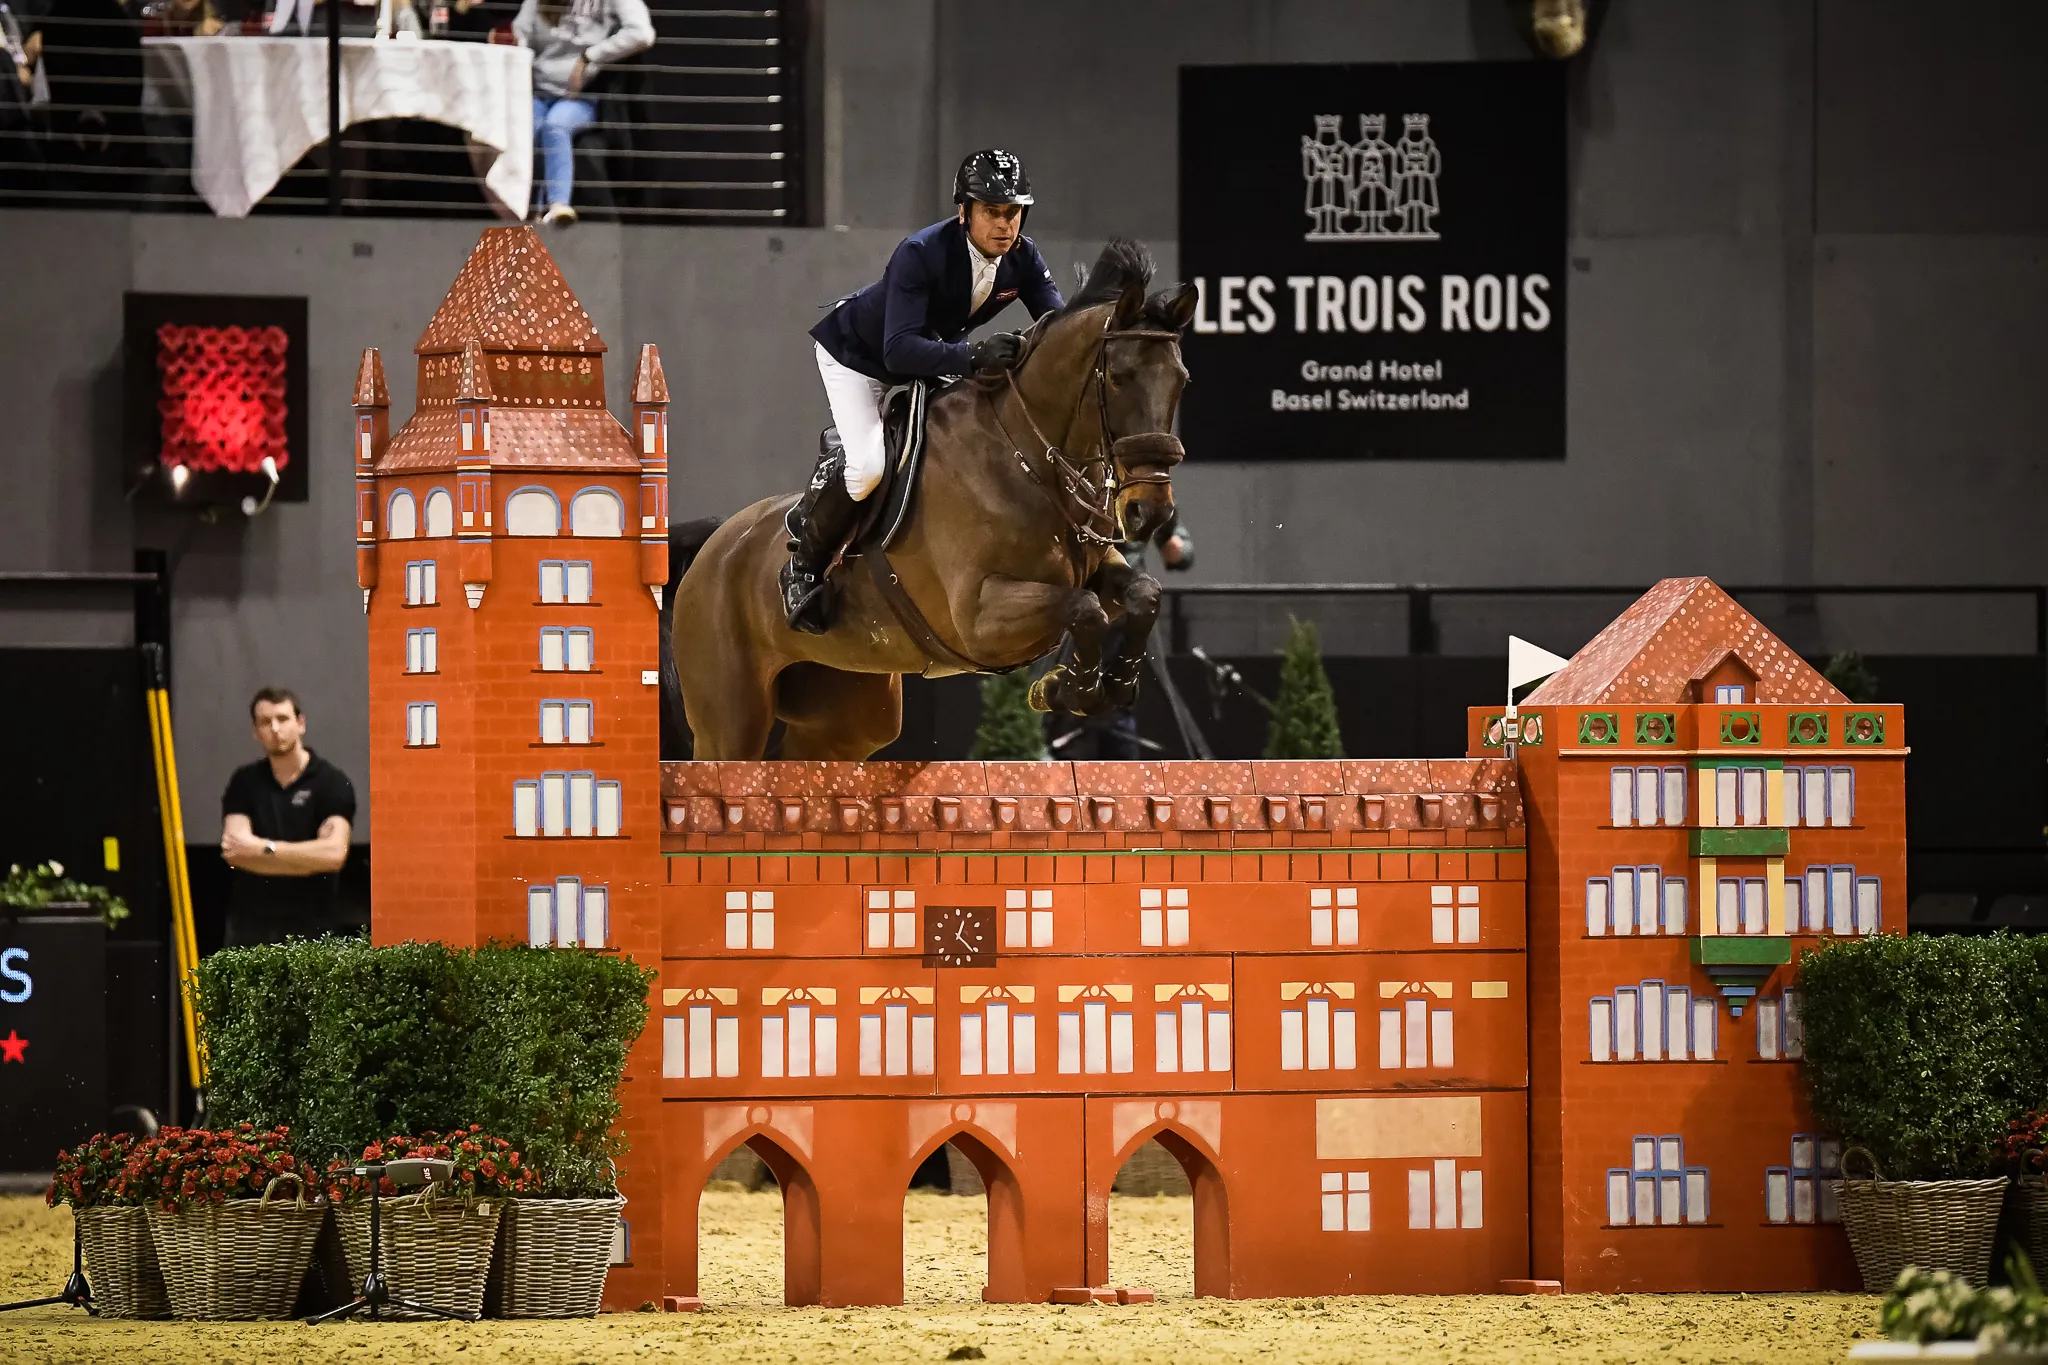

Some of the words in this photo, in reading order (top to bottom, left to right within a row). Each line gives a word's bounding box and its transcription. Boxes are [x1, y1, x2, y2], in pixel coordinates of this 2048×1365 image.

[1194, 275, 1276, 333] LES
[1287, 275, 1427, 333] TROIS
[1441, 274, 1552, 332] ROIS
[1302, 360, 1373, 382] Grand
[1379, 360, 1443, 382] Hotel
[1271, 389, 1332, 411] Basel
[1338, 388, 1469, 411] Switzerland
